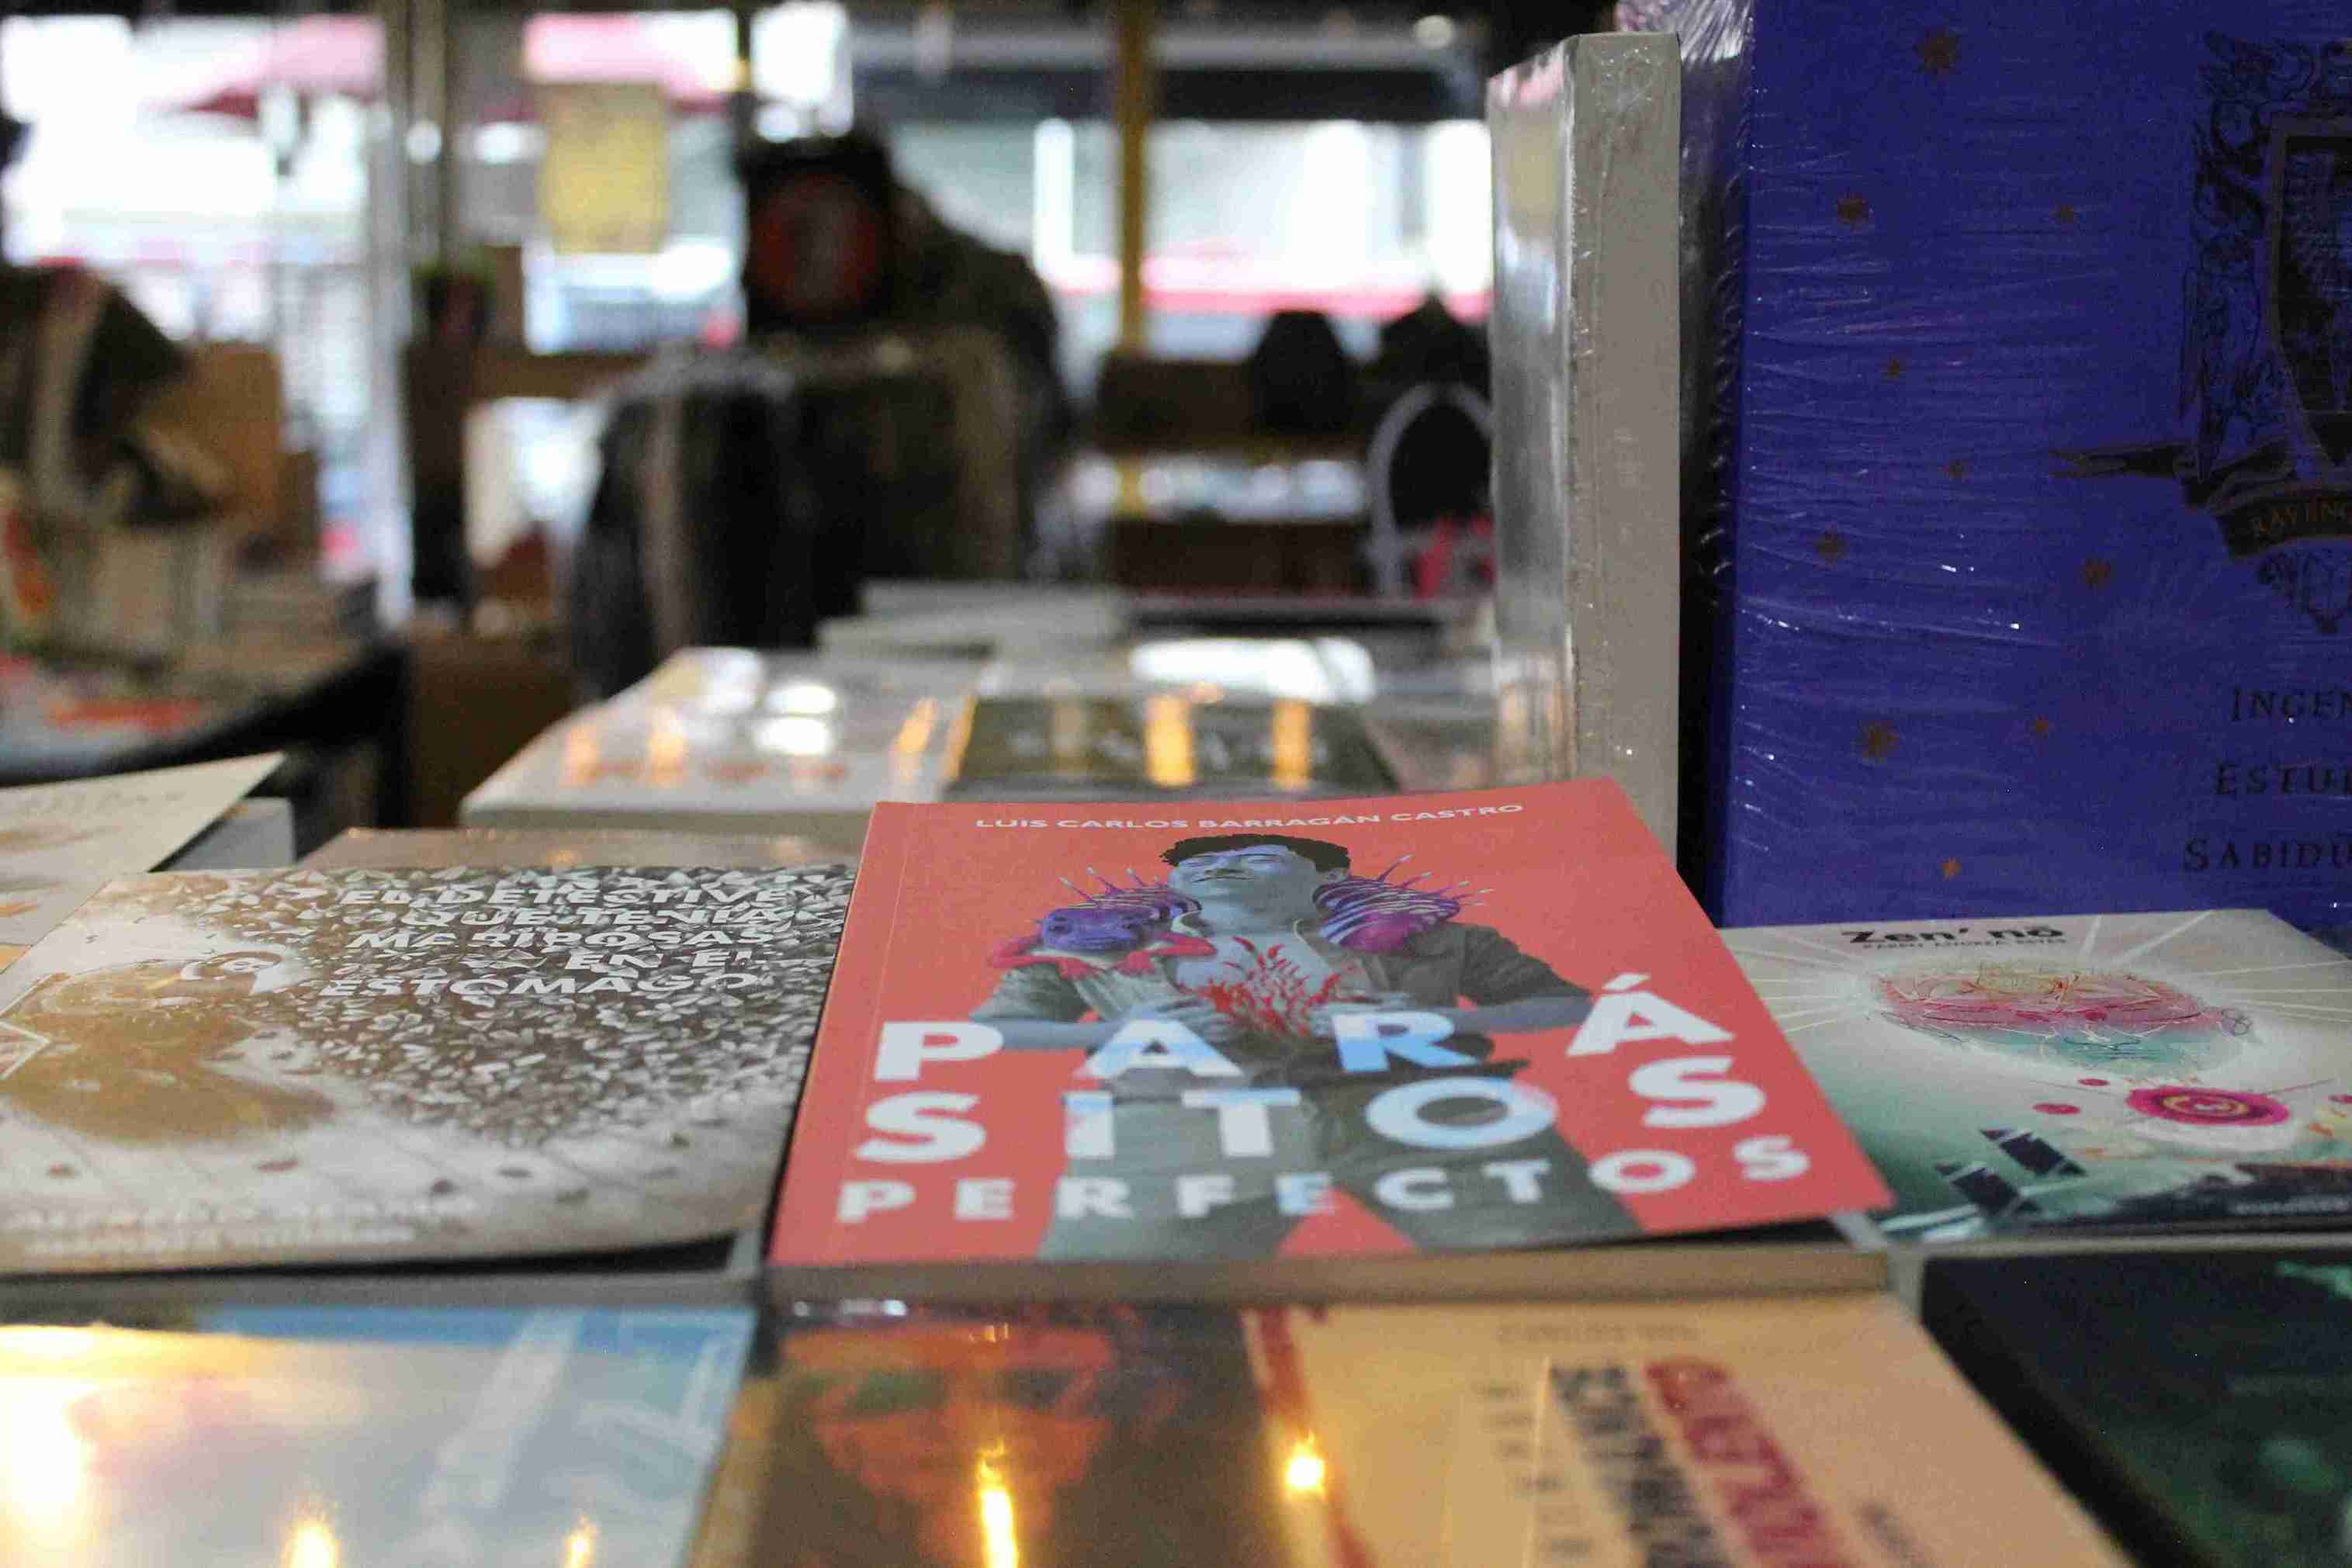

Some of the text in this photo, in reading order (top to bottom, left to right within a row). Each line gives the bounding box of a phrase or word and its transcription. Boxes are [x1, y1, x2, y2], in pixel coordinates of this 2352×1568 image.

[975, 819, 1048, 829] LUIS
[1057, 819, 1189, 829] CARLOS
[1390, 805, 1524, 821] CASTRO
[837, 1135, 1810, 1224] PERFECTOS
